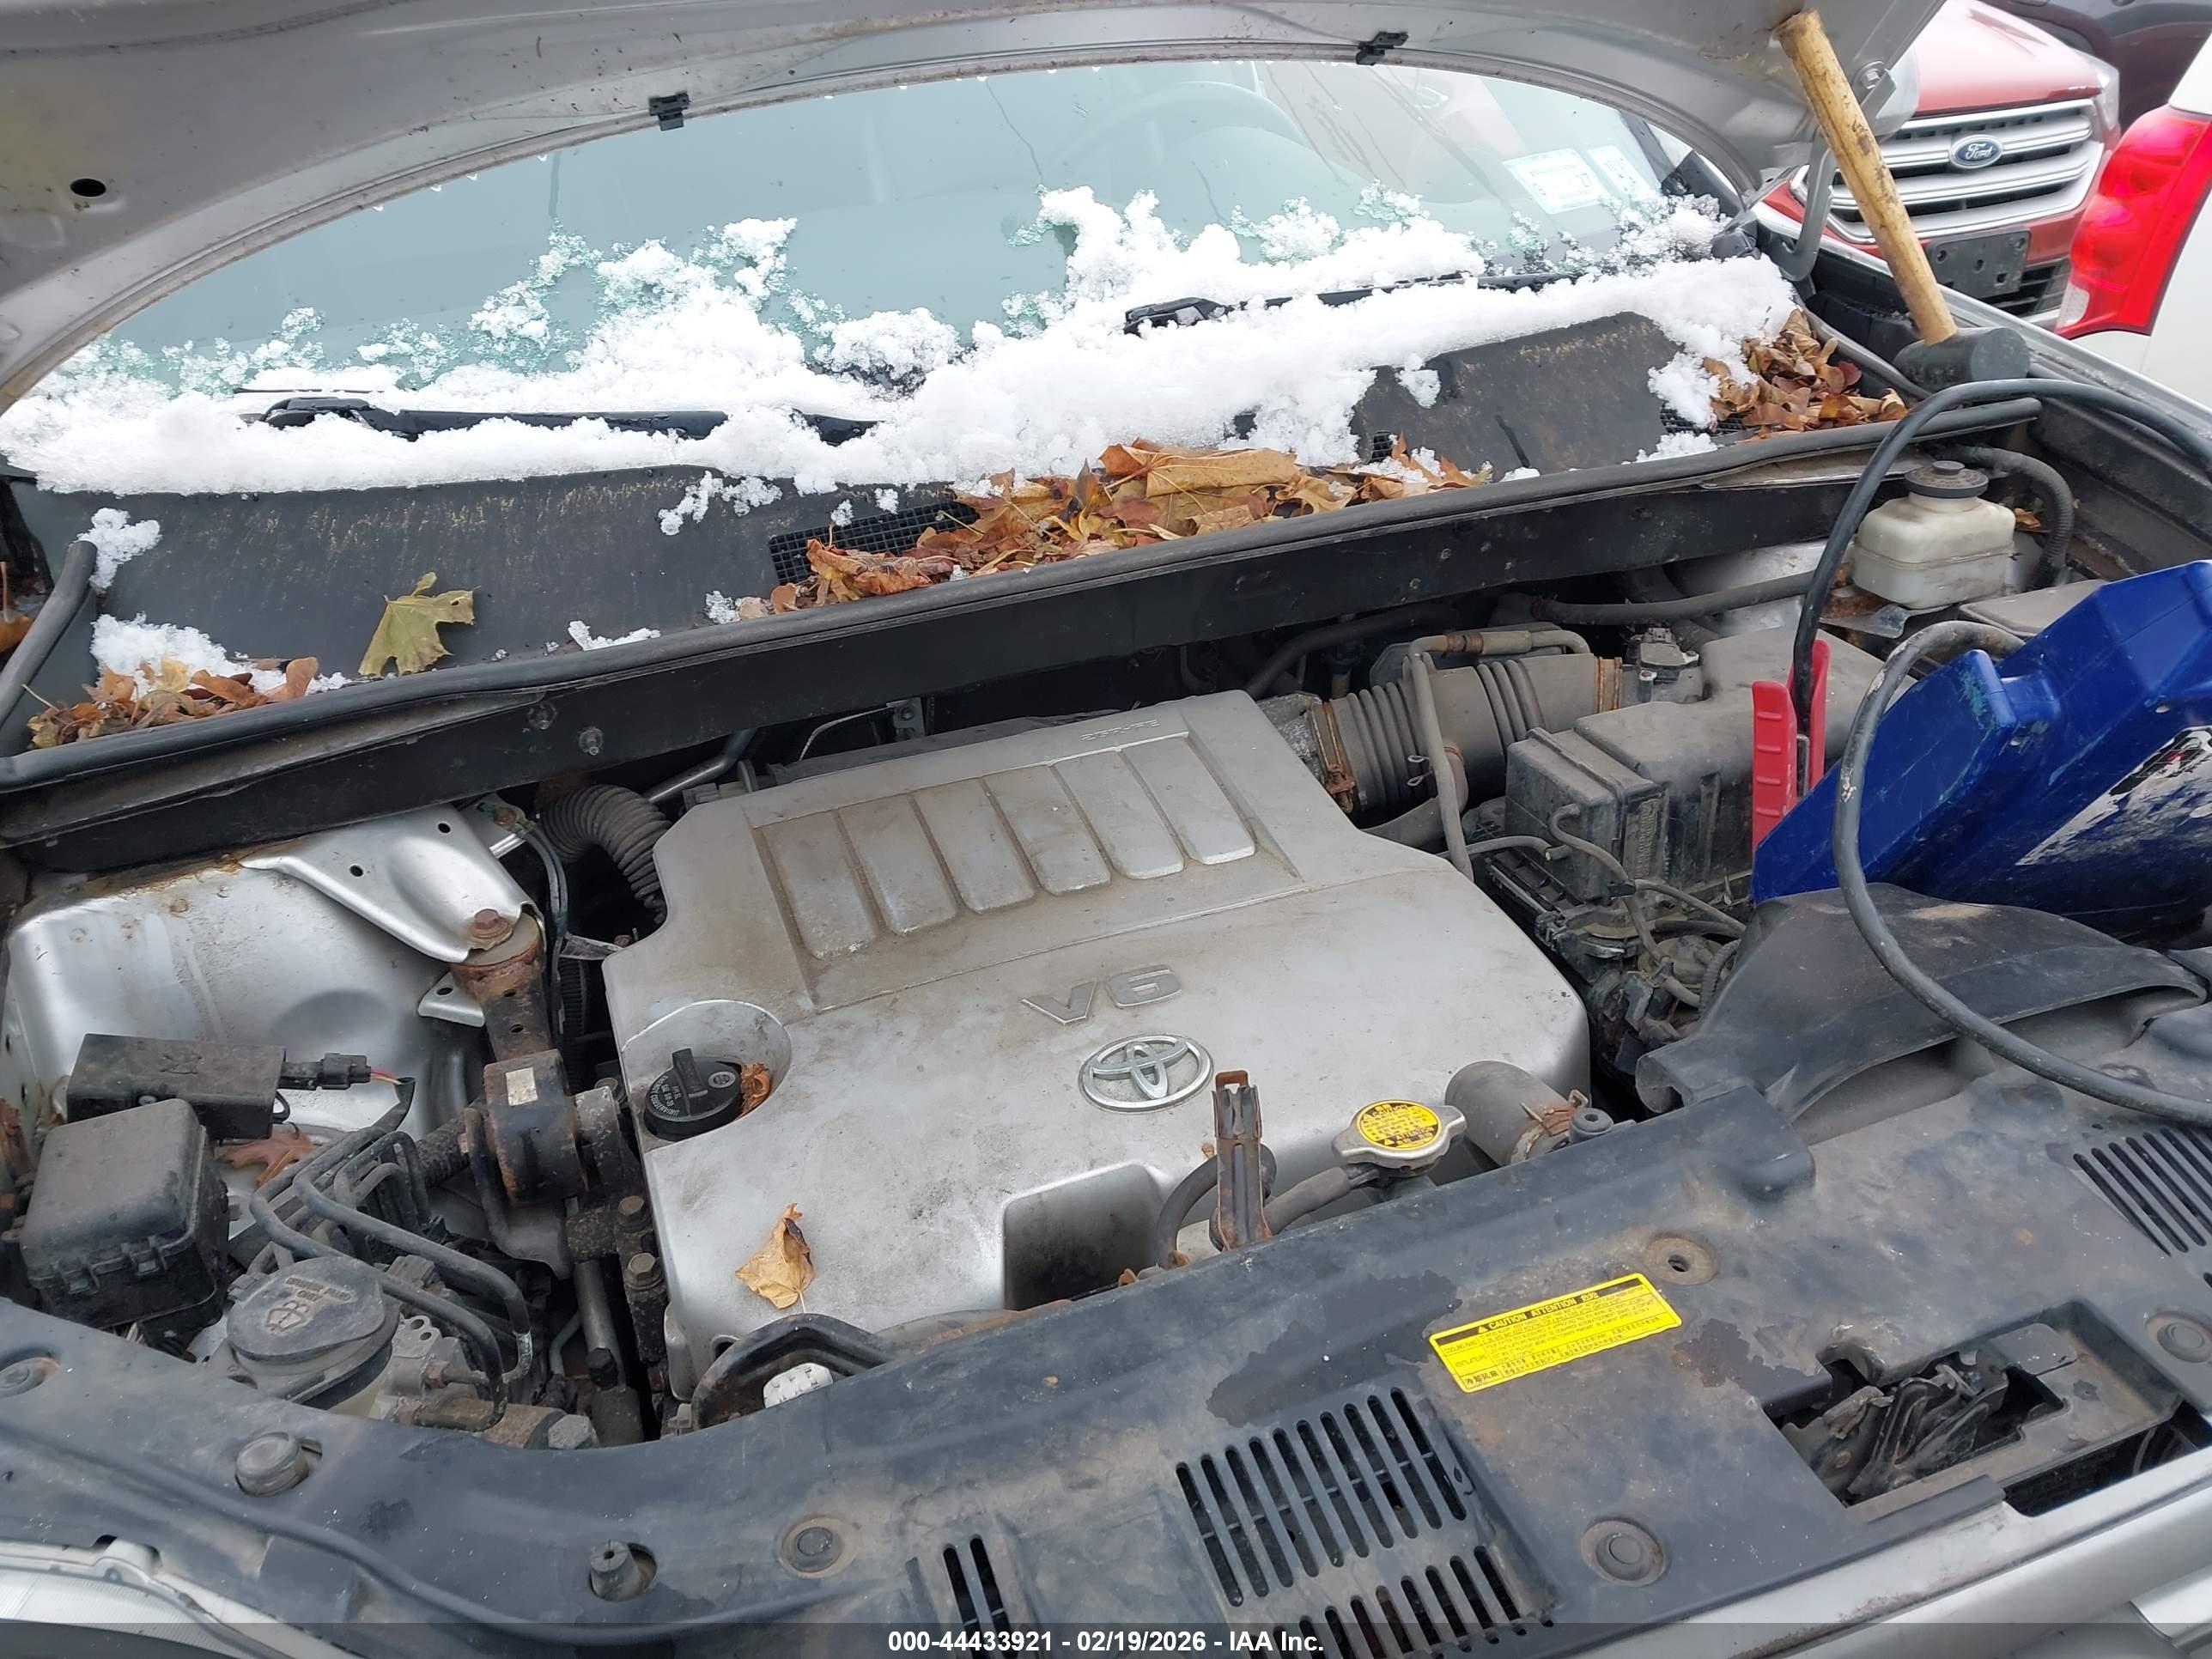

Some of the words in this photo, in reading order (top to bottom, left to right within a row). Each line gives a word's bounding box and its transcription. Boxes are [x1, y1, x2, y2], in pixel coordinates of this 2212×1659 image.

[1965, 143, 1993, 160] Ford
[1020, 964, 1182, 1025] V6
[649, 1094, 680, 1116] CONSERVING
[1487, 1311, 1528, 1331] CAUTION
[1530, 1296, 1577, 1317] ATTENTION
